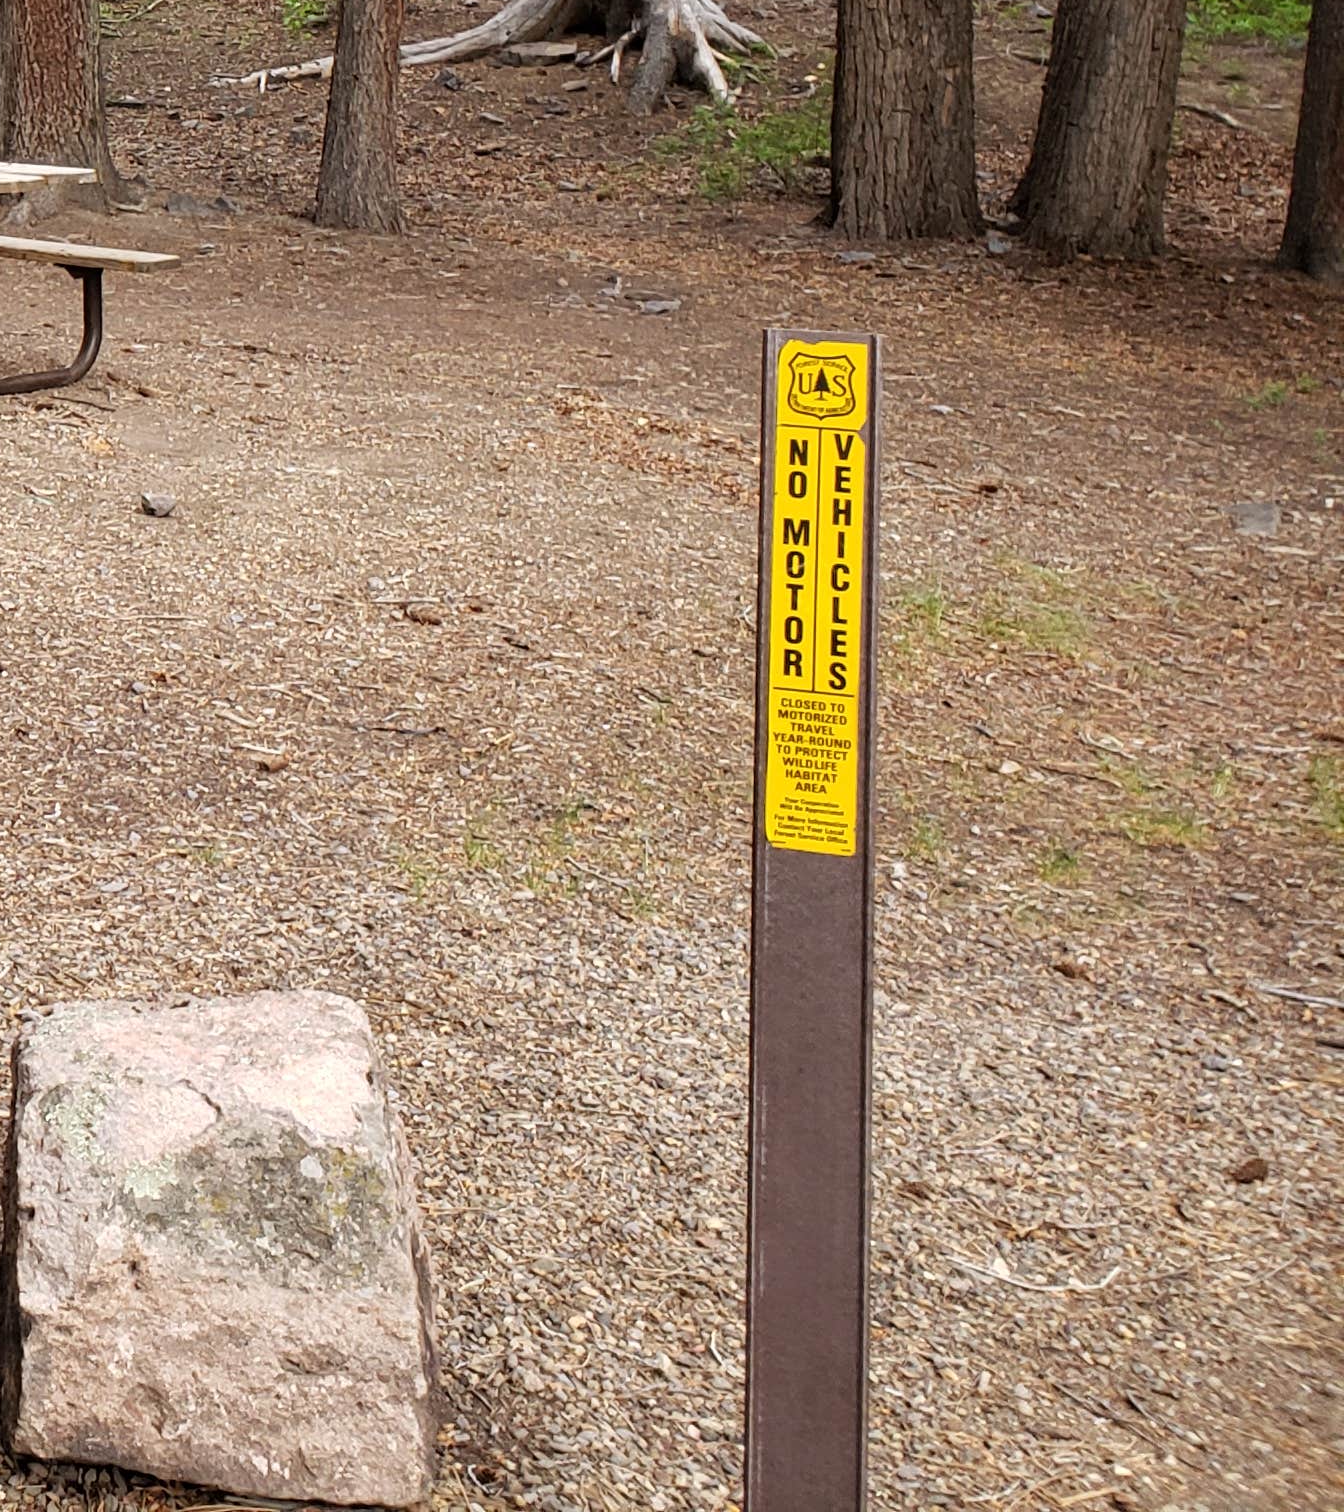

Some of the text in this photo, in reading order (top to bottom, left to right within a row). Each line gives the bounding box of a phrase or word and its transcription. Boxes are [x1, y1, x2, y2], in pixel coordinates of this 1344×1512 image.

[782, 438, 810, 678] NO MOTOR
[827, 433, 854, 691] VEHICLES
[780, 697, 845, 714] CLOSED TO
[777, 709, 848, 726] MOTORIZED
[790, 721, 835, 736] TRAVEL
[772, 732, 852, 750] YEAR-ROUND
[776, 743, 848, 761] TO PROTECT
[782, 756, 838, 772] WILDLIFE
[785, 768, 838, 784] HABITAT
[794, 781, 828, 794] AREA
